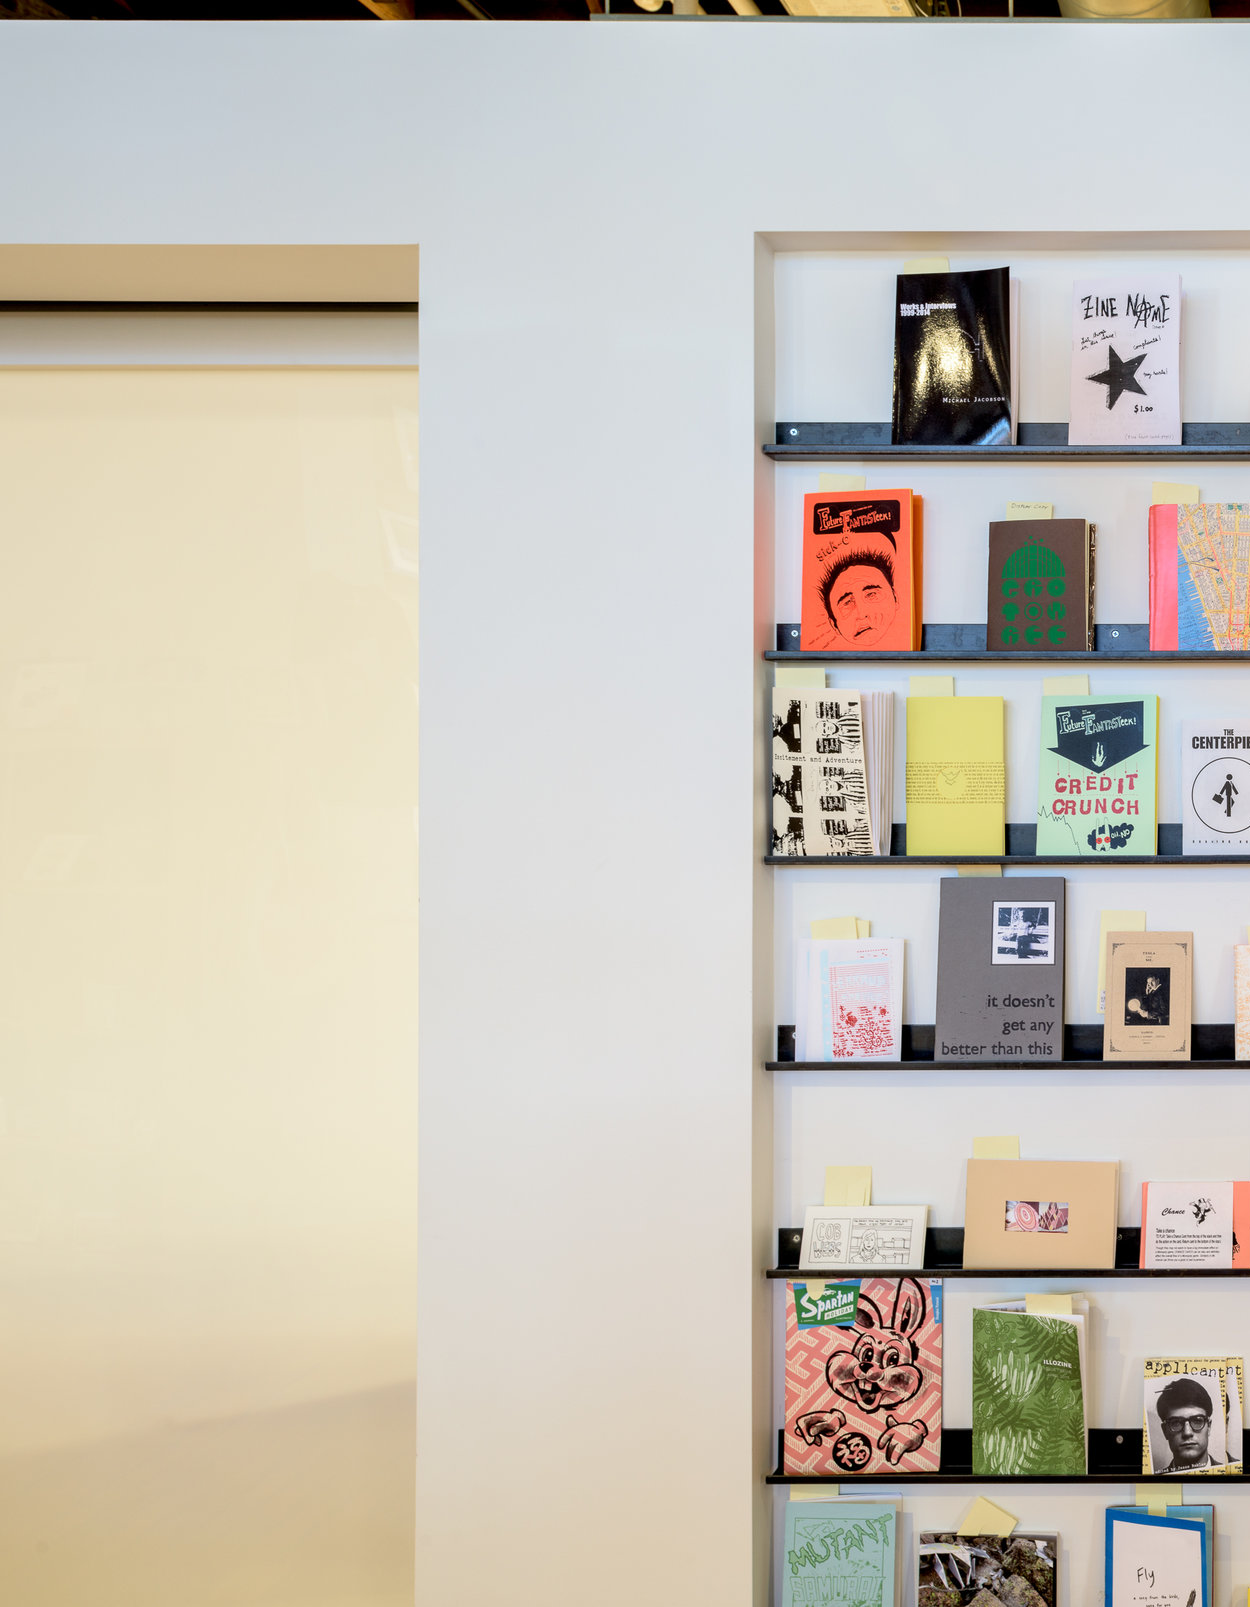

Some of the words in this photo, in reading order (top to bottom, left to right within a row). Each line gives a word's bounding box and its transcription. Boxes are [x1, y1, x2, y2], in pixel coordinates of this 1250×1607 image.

[1080, 295, 1119, 321] ZINE
[1126, 293, 1170, 329] NAME
[809, 754, 822, 763] and
[825, 756, 863, 764] Adventure
[1055, 774, 1139, 794] CREDIT
[1052, 798, 1139, 816] CRUNCH
[987, 994, 998, 1008] it
[1002, 994, 1055, 1008] doesn't
[1002, 1019, 1026, 1035] get
[1030, 1020, 1055, 1035] any
[941, 1041, 987, 1056] better
[991, 1041, 1023, 1056] than
[1028, 1041, 1053, 1056] this
[1161, 1207, 1186, 1216] Chance
[1043, 1359, 1072, 1369] ILLOZINE
[1145, 1360, 1225, 1378] applicant
[788, 1513, 893, 1575] MUTANT
[1136, 1566, 1155, 1588] Fly
